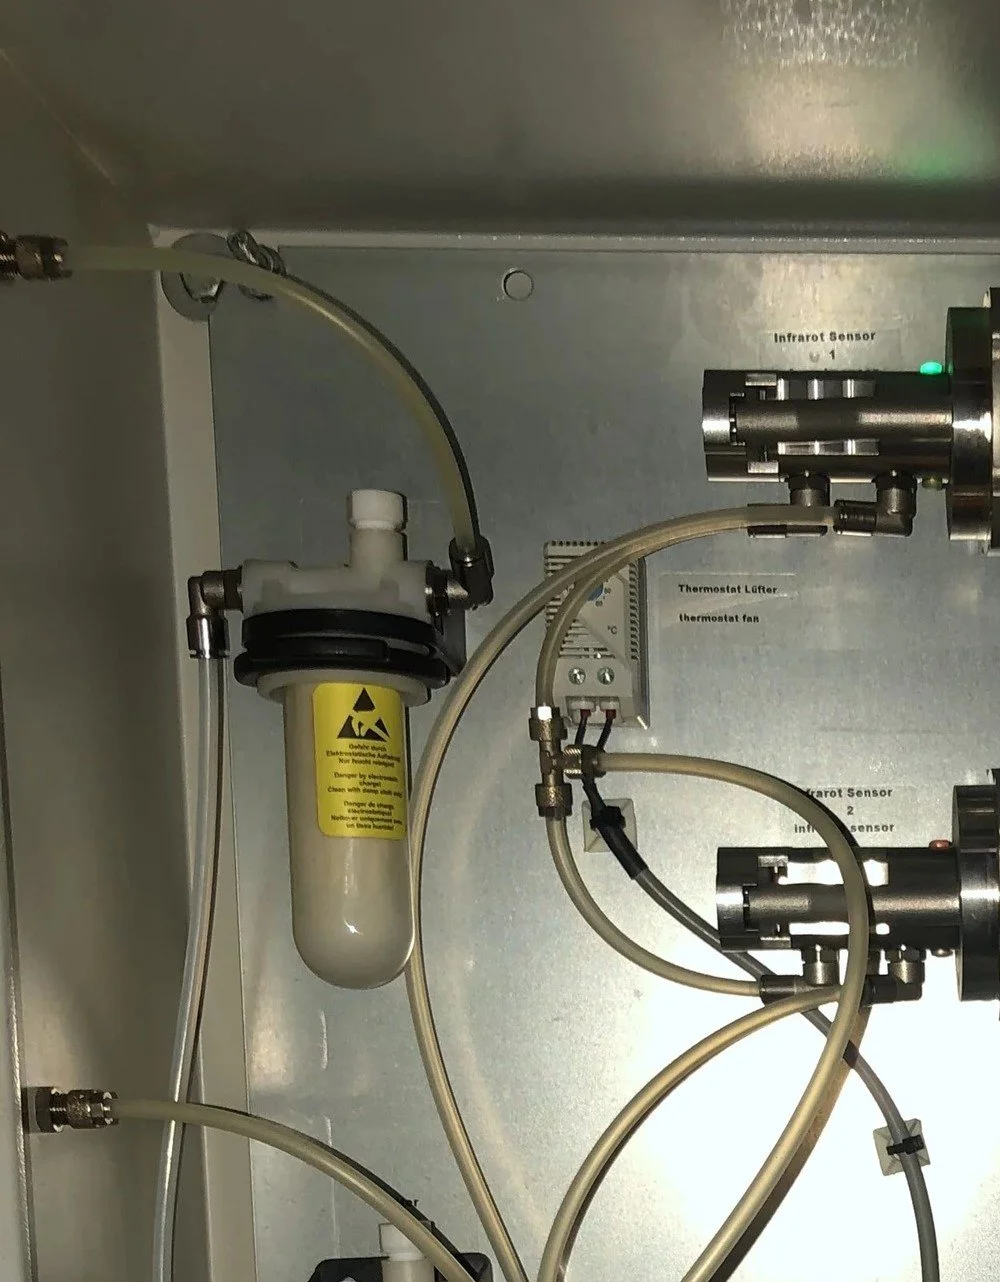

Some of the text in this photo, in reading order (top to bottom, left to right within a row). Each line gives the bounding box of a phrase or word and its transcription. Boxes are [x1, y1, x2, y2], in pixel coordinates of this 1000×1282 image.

[774, 329, 876, 343] Infrarot Sensor
[829, 349, 836, 360] 1
[678, 583, 778, 595] Thermostat Lüfter
[679, 613, 760, 624] thermostat fan
[847, 788, 893, 798] Sensor
[846, 805, 854, 815] 2
[850, 824, 895, 833] sensor
